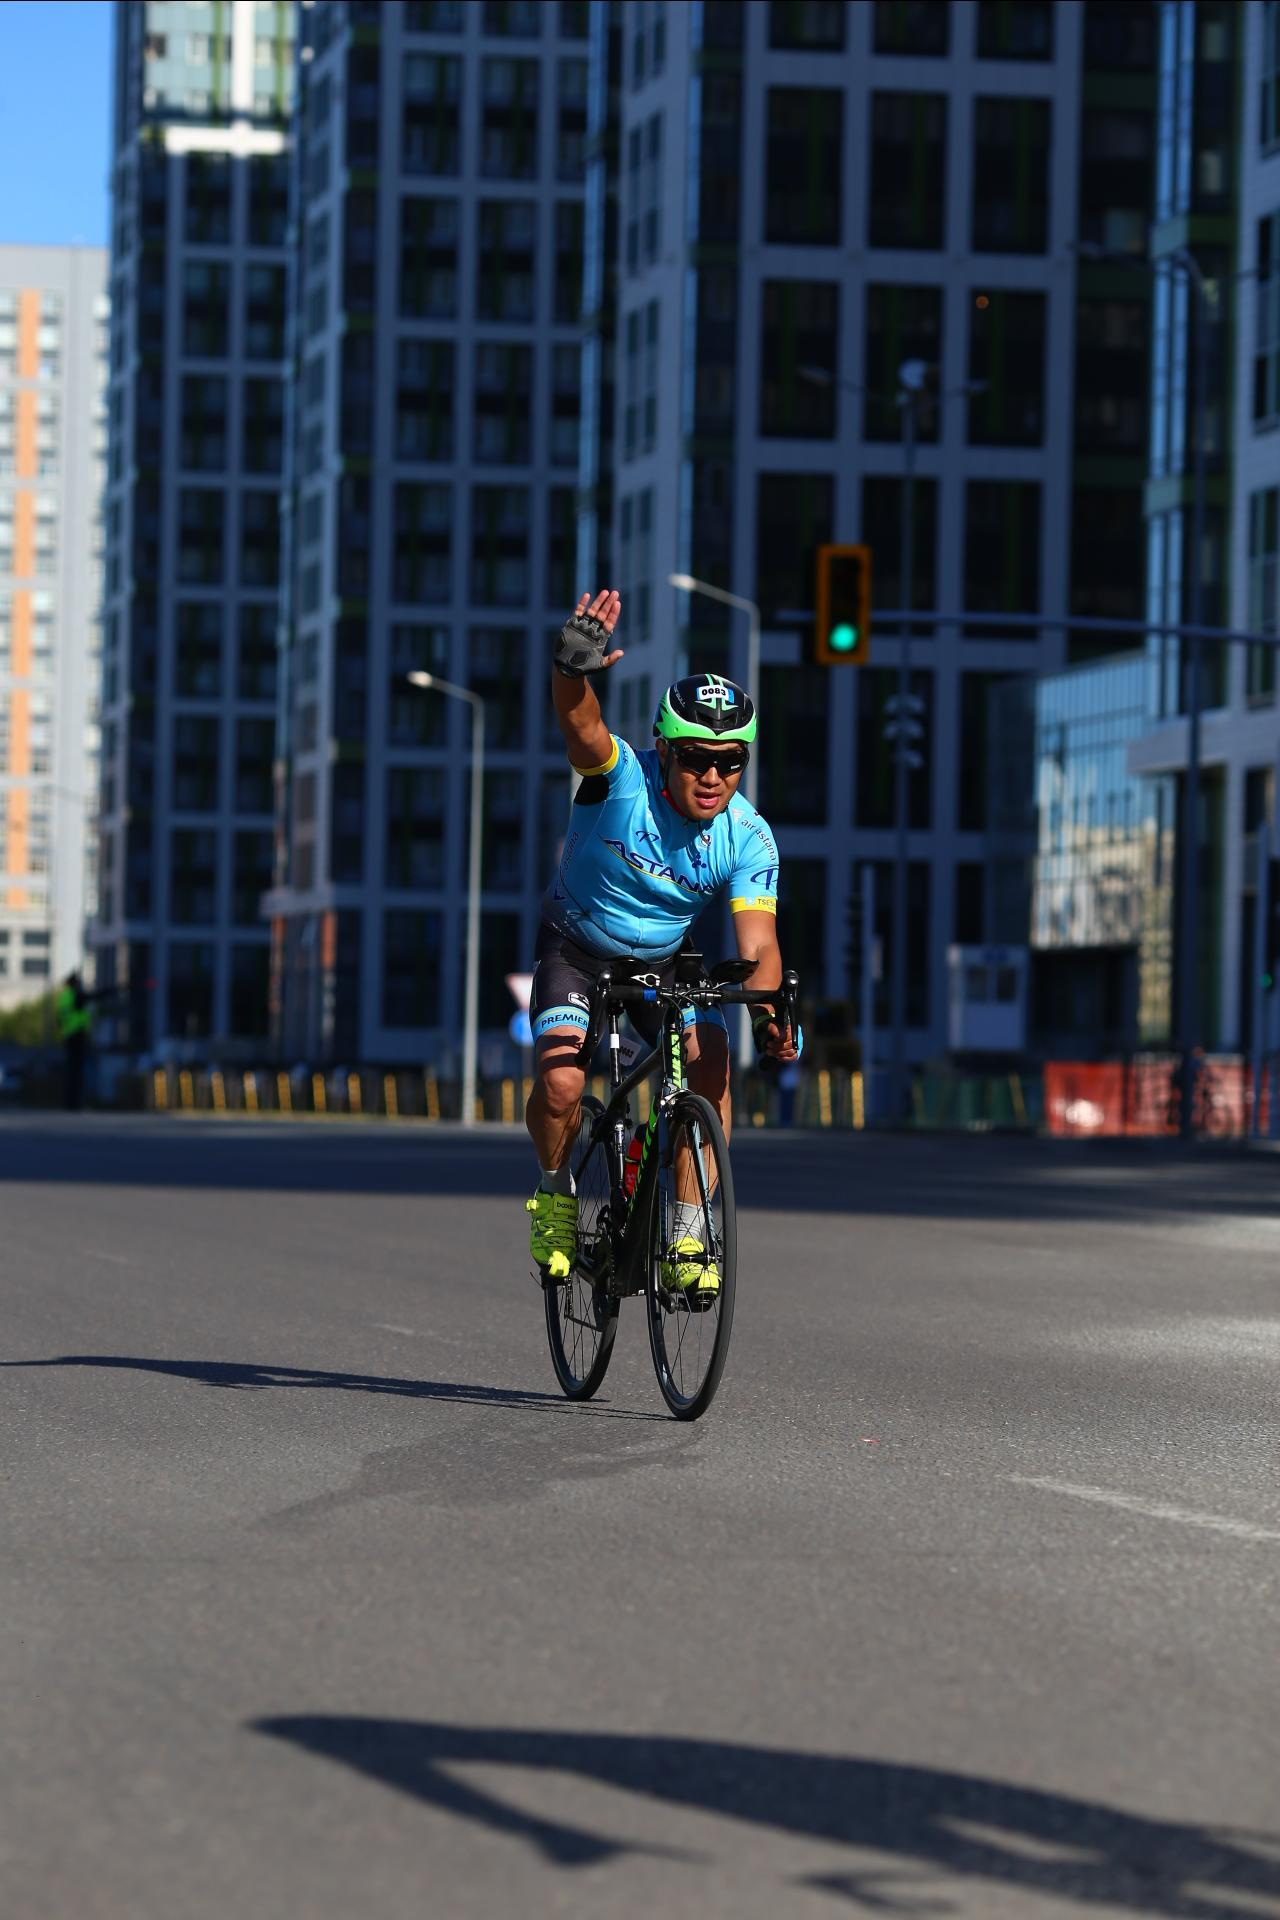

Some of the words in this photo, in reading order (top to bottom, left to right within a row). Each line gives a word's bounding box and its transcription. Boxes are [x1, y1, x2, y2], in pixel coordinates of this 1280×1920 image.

[701, 687, 726, 696] 0083
[741, 819, 756, 832] air
[755, 827, 777, 861] astana
[541, 1013, 588, 1029] PREMIER
